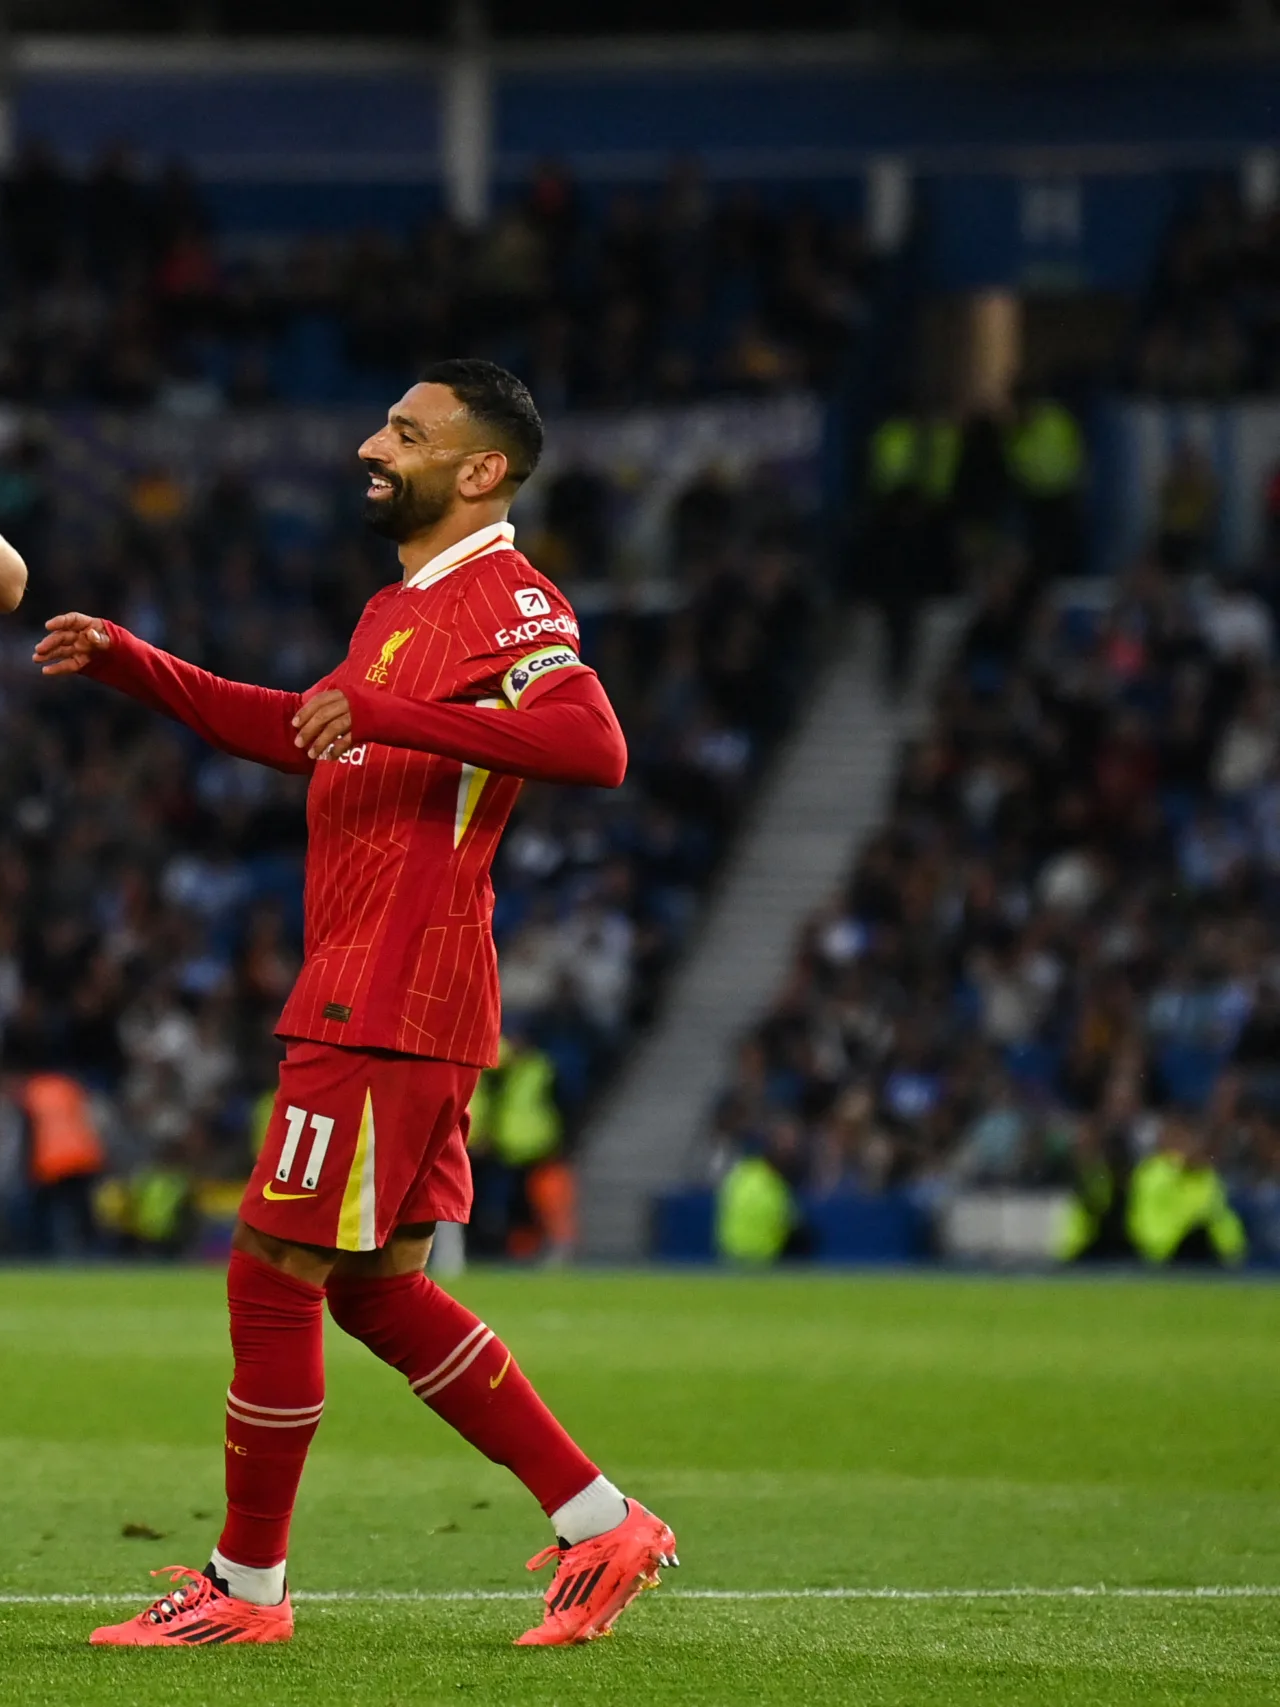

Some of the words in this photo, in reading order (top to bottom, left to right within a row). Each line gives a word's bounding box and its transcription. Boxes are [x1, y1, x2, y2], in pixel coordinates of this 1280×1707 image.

[528, 652, 578, 672] Capt
[365, 667, 389, 684] LFC
[275, 1105, 335, 1190] 11
